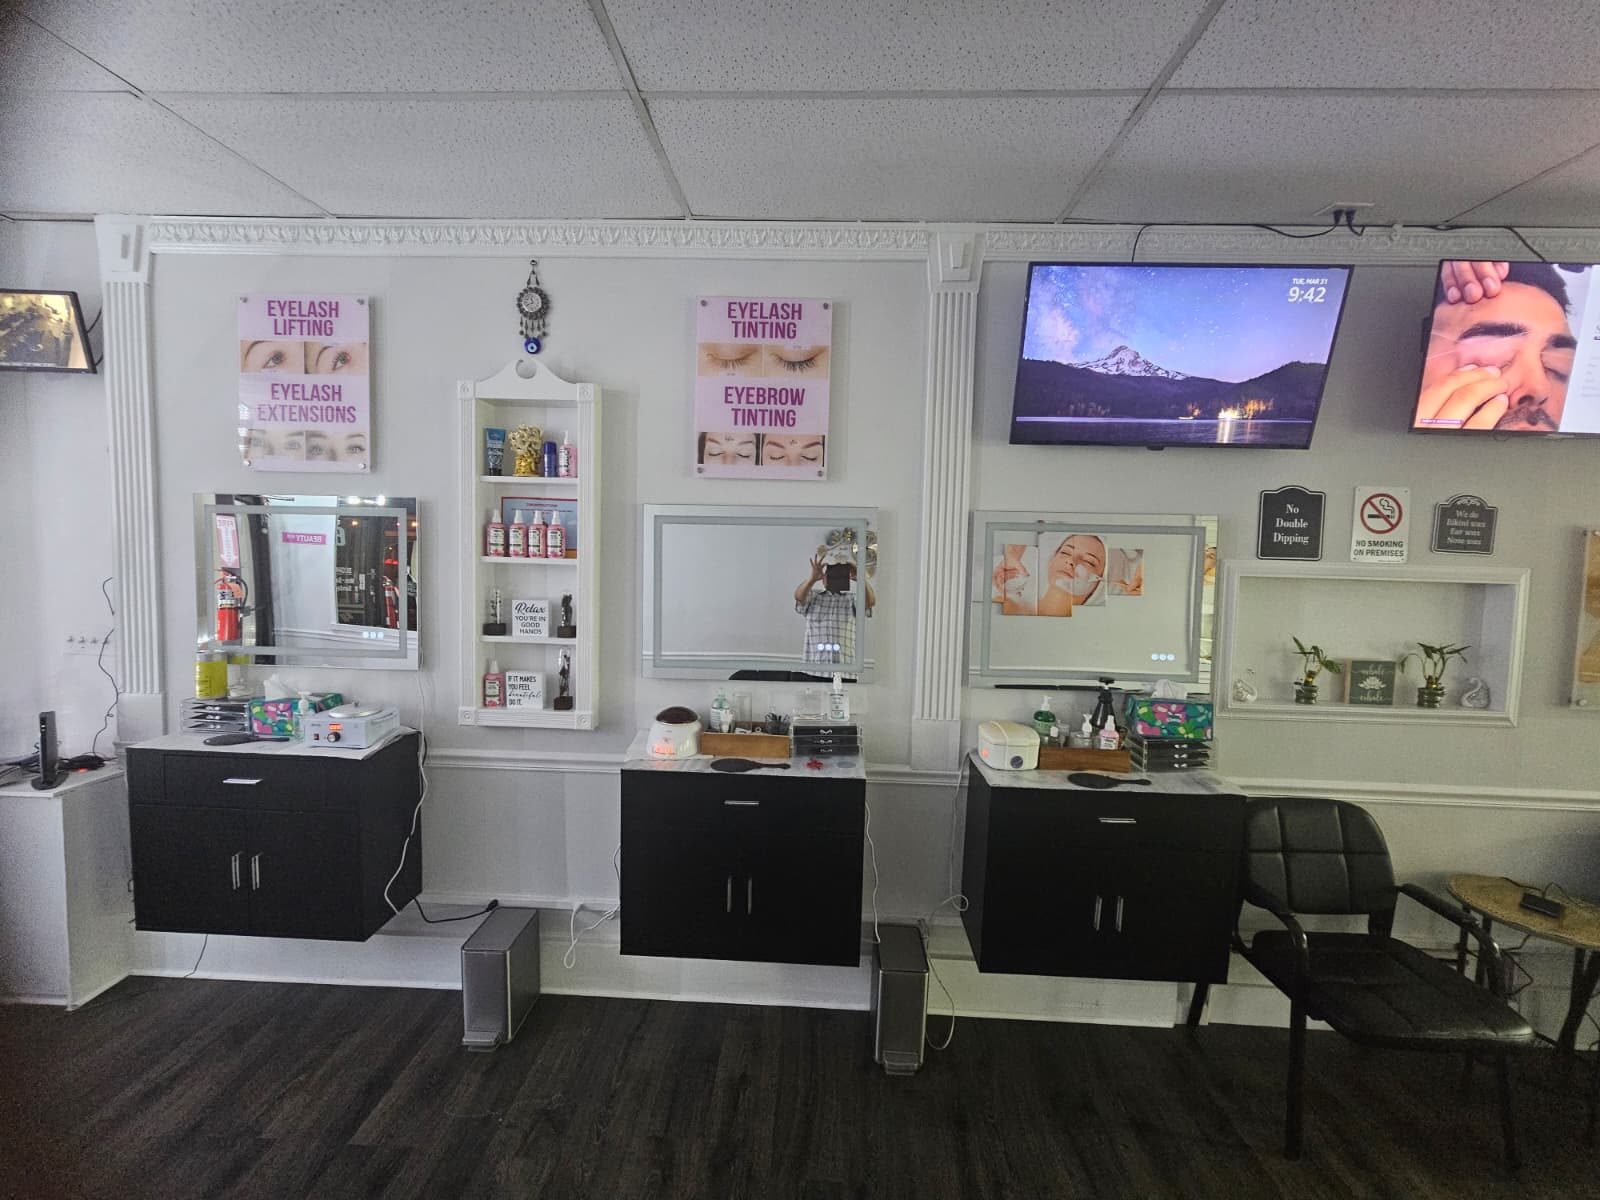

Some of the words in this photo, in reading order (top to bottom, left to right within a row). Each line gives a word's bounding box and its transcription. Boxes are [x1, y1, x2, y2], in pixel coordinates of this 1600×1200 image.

[1288, 286, 1326, 303] 9:42
[267, 300, 339, 318] EYELASH
[727, 302, 802, 320] EYELASH
[273, 318, 334, 336] LIFTING
[731, 320, 797, 339] TINTING
[271, 383, 342, 402] EYELASH
[724, 386, 805, 406] EYEBROW
[257, 404, 356, 423] EXTENSIONS
[731, 408, 797, 427] TINTING
[1286, 503, 1299, 514] No
[1275, 517, 1309, 528] Double
[1273, 532, 1309, 545] Dipping
[1367, 540, 1404, 548] SMOKING
[1366, 549, 1404, 557] PREMISES
[515, 602, 546, 615] Relax
[519, 675, 537, 683] MAKES
[508, 691, 542, 700] beautiful
